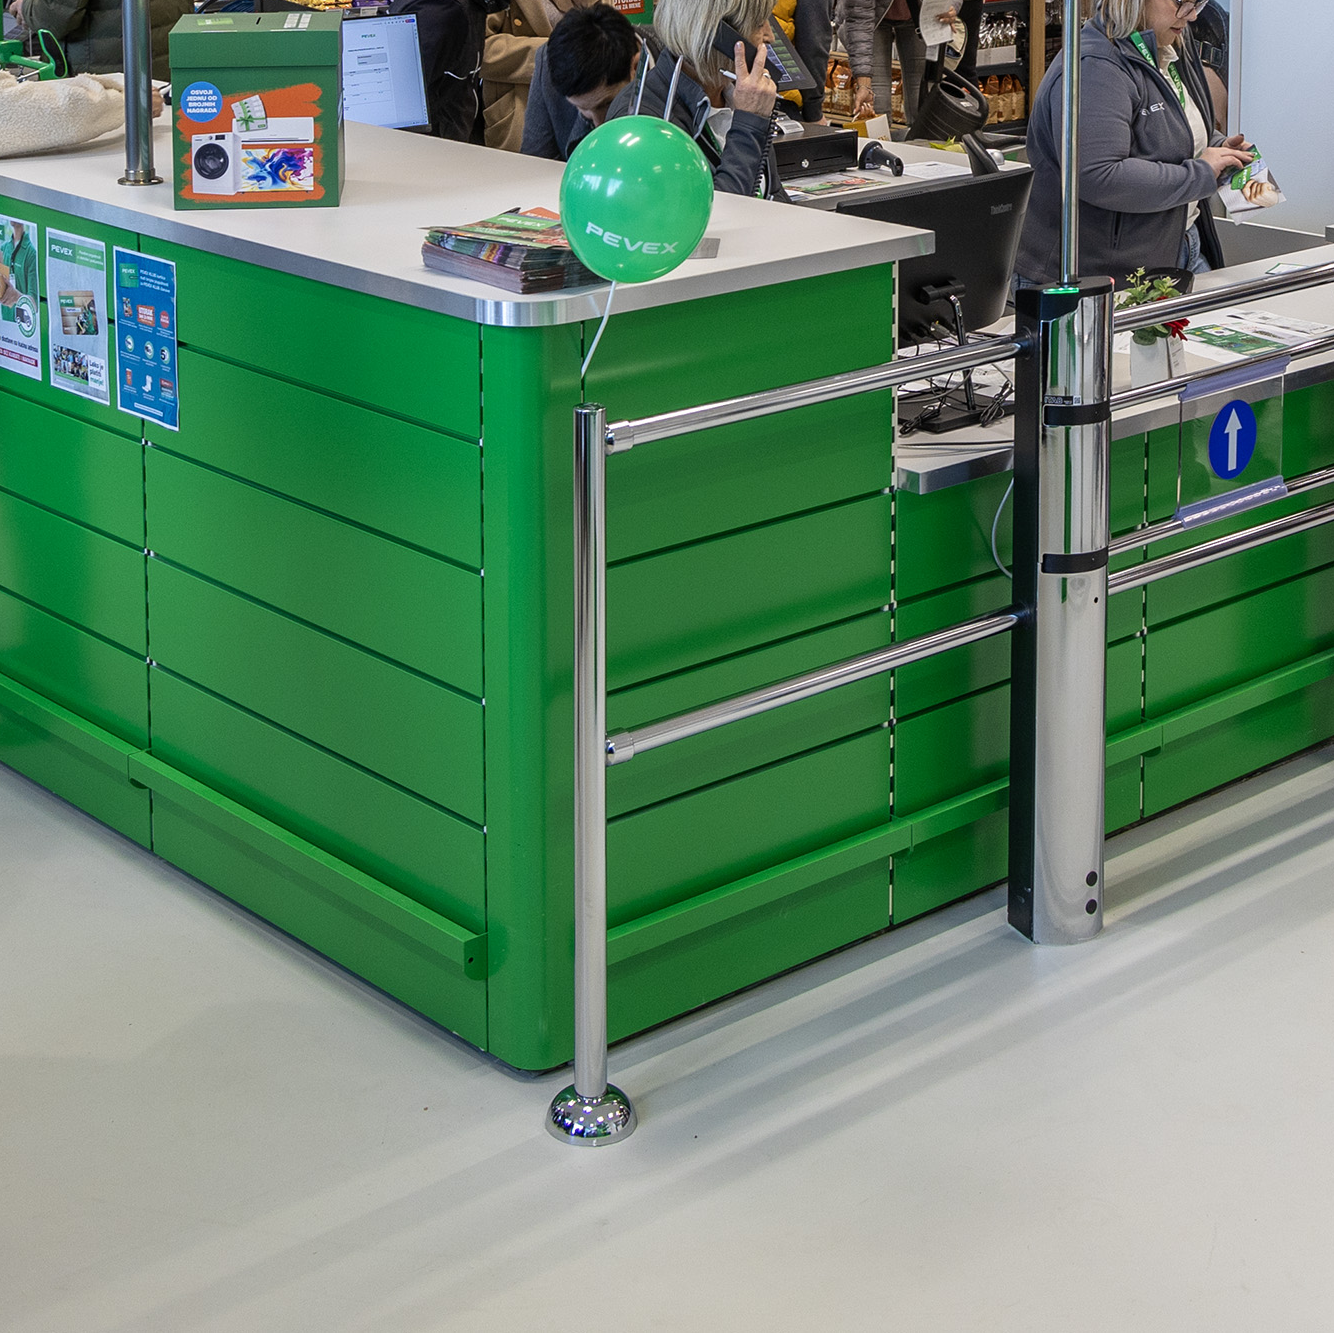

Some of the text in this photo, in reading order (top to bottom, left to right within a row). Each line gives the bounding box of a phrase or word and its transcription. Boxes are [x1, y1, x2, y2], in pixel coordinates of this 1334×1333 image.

[497, 216, 546, 228] PEVEX
[584, 221, 679, 255] PEVEX
[51, 244, 73, 257] PEVEX
